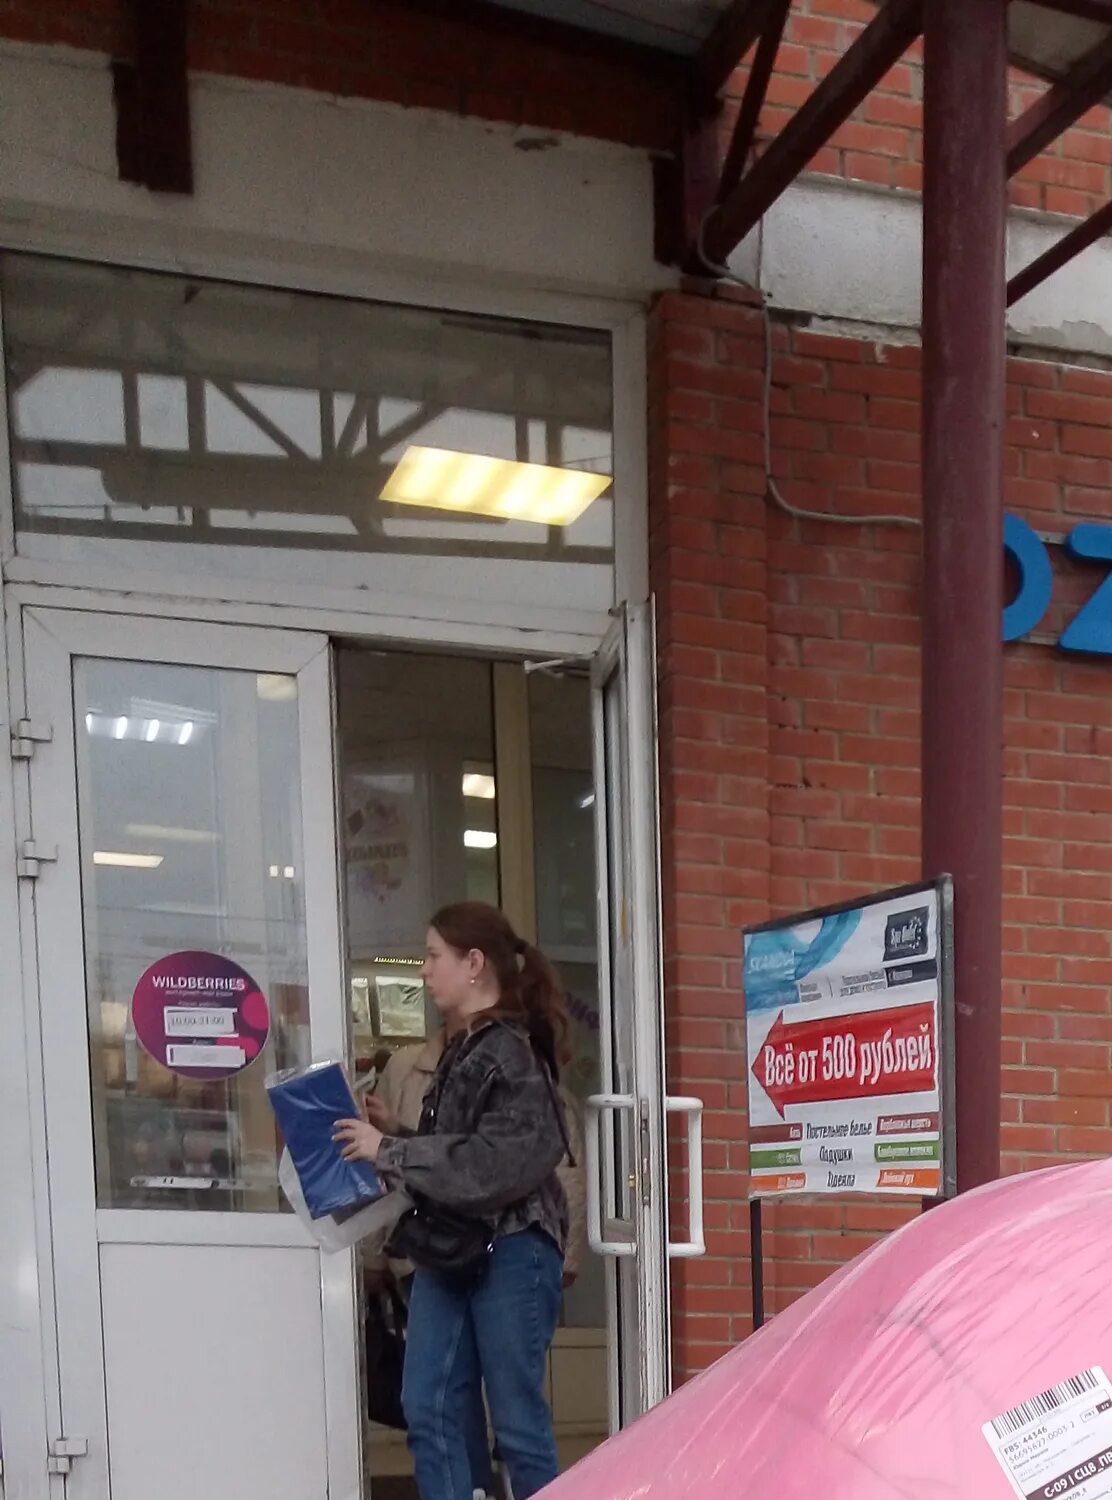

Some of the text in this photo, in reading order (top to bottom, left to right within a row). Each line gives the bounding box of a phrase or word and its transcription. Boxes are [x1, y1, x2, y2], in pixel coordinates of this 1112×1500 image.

[152, 976, 245, 991] WILDBERRIES
[765, 1023, 932, 1087] Всё от 500 рублей
[1021, 1425, 1048, 1444] 44346
